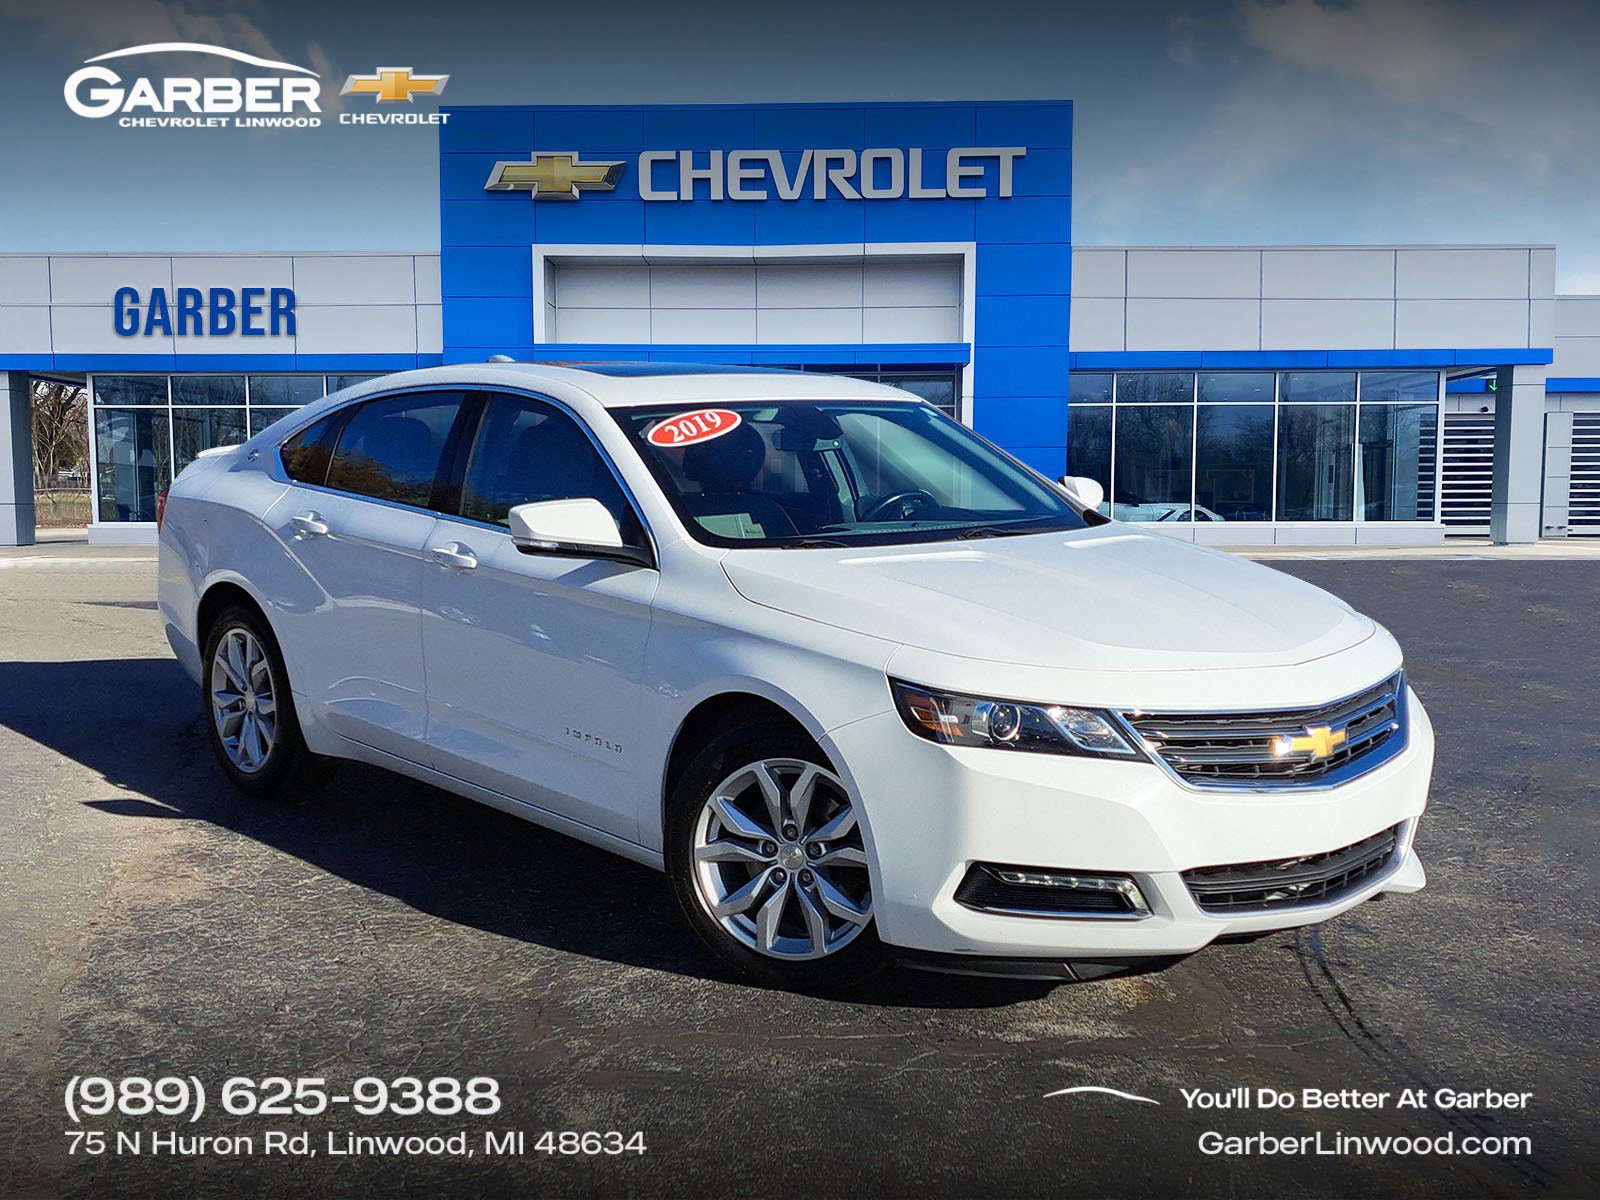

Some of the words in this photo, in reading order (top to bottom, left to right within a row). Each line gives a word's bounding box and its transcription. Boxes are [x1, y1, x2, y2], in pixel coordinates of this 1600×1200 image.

[638, 146, 1027, 201] CHEVROLET
[113, 286, 297, 337] GARBER
[664, 411, 723, 443] 2019
